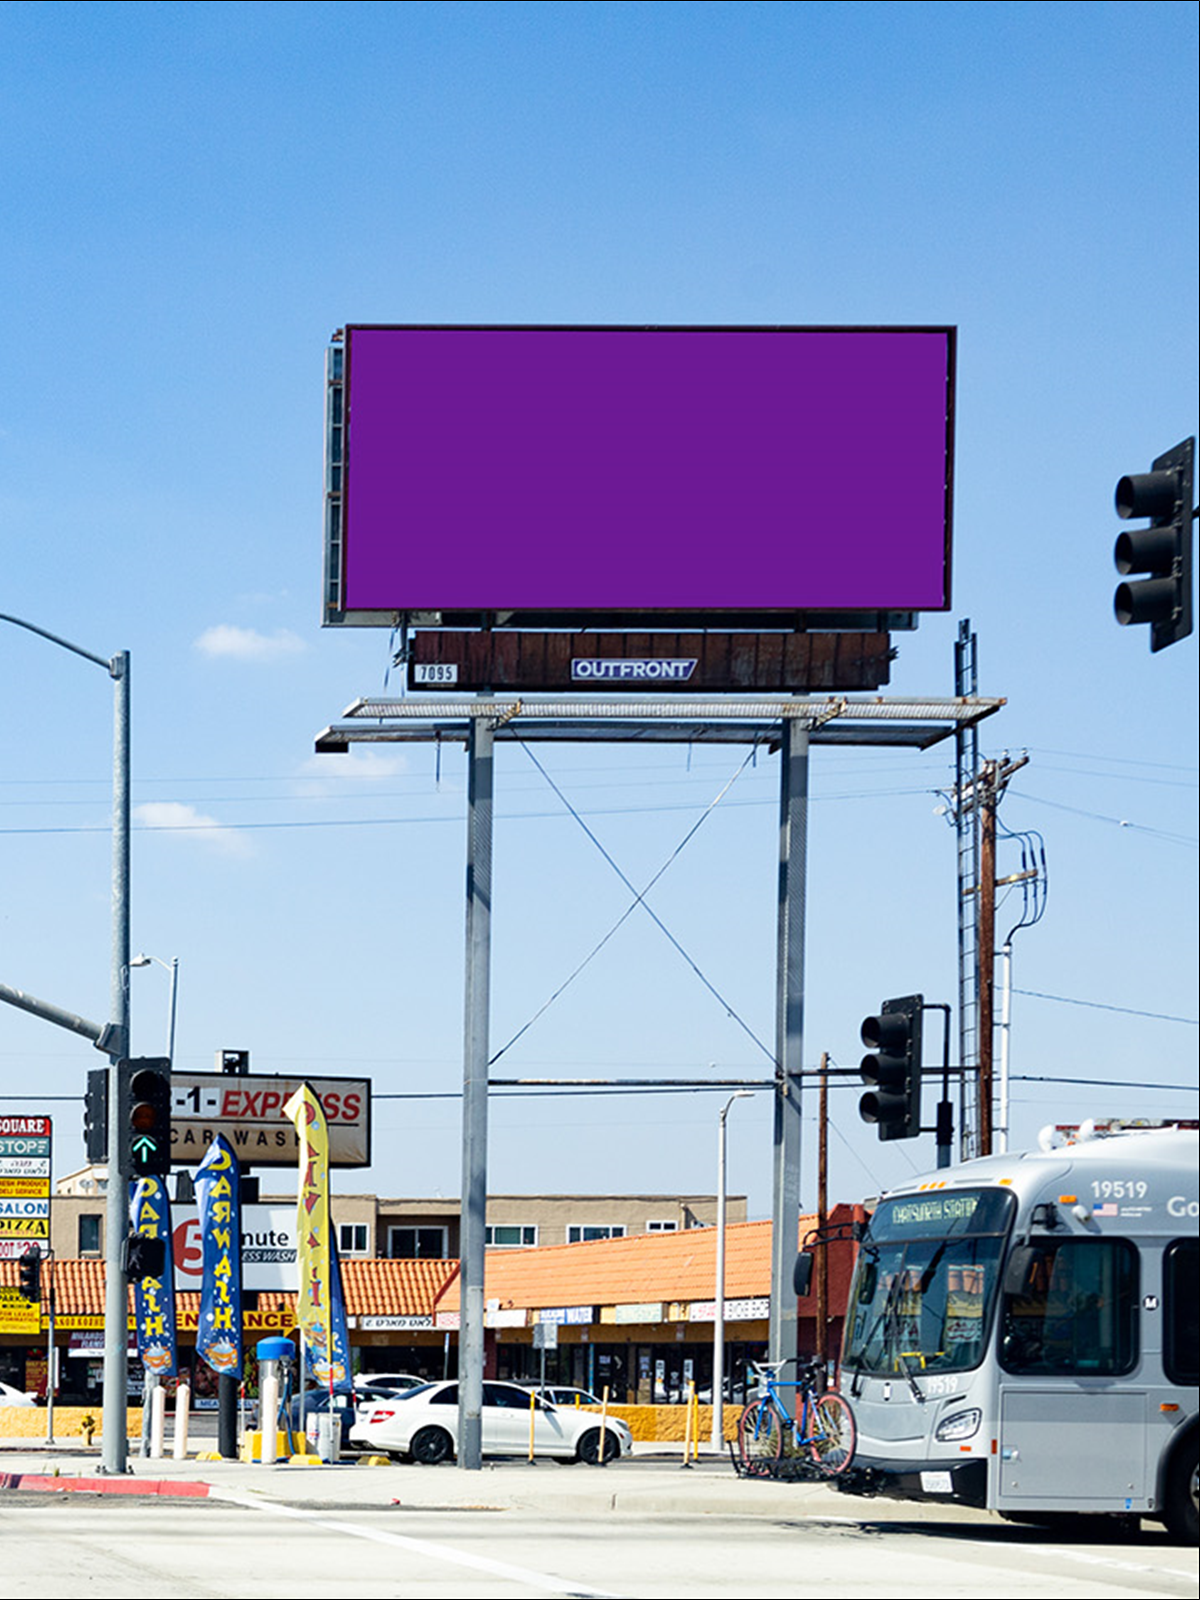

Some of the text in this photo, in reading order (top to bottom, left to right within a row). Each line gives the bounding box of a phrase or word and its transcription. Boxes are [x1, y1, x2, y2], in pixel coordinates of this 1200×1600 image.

[420, 665, 453, 680] 7095
[576, 661, 689, 678] OUTFRONT
[221, 1090, 361, 1120] EXPSS
[170, 1128, 214, 1145] CAR
[1091, 1180, 1148, 1199] 19519
[1167, 1196, 1199, 1217] Go
[182, 1224, 202, 1269] 5
[241, 1230, 289, 1247] nute
[262, 1250, 297, 1262] WASH
